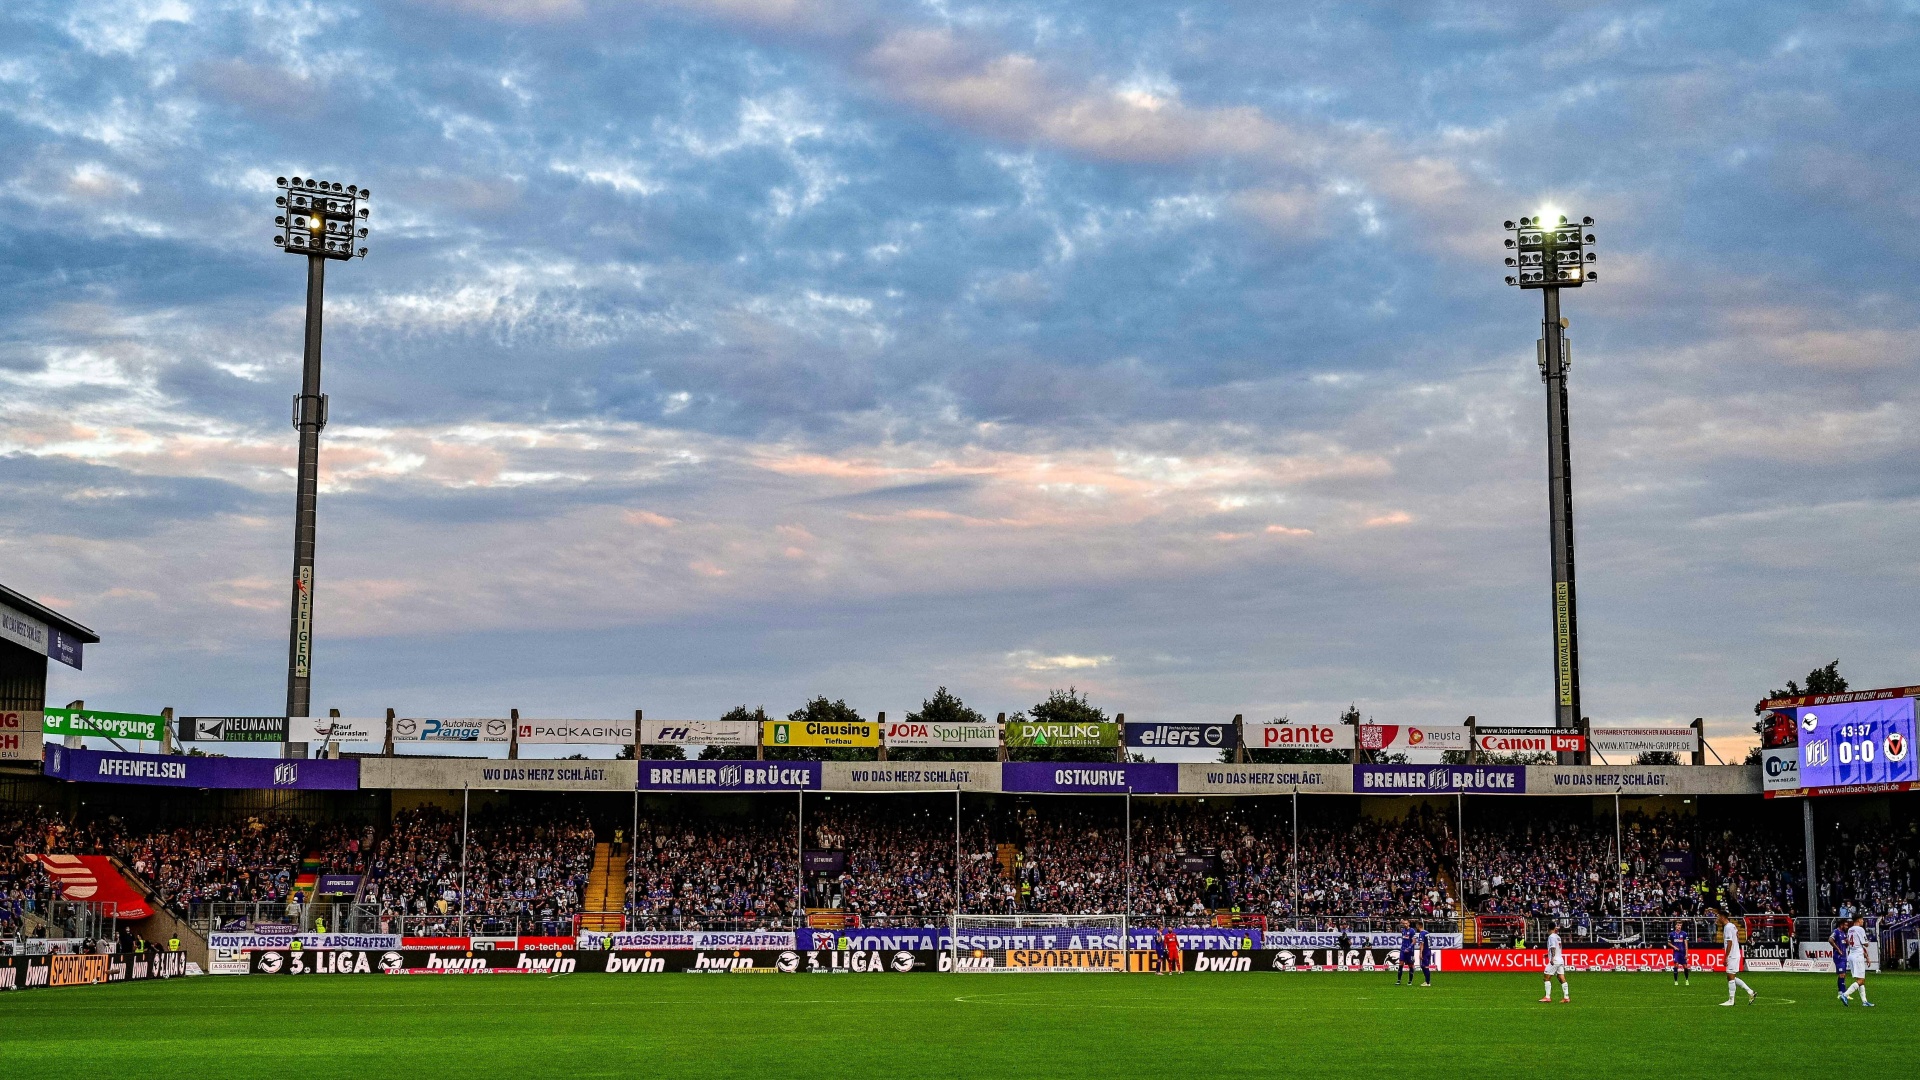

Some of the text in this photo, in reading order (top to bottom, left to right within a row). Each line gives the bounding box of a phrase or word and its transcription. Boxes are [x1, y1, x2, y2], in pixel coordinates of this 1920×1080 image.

[1557, 583, 1568, 636] IBBENBÜREN
[1560, 638, 1570, 695] KLETTERWALD
[1827, 694, 1853, 703] DENKEN
[70, 713, 155, 738] Entsorgung
[225, 719, 282, 731] NEUMANN
[420, 719, 480, 740] Prange
[441, 720, 482, 728] Autohaus
[806, 723, 870, 738] Clausing
[888, 724, 928, 737] JOPA
[1022, 725, 1100, 738] DARLING
[1841, 725, 1871, 737] 43:37
[226, 733, 245, 741] ZELTE
[255, 732, 282, 741] PLANEN
[535, 727, 632, 737] PACKAGING
[658, 728, 689, 740] FH
[1140, 726, 1200, 745] ellers
[1264, 725, 1334, 747] pante
[1428, 731, 1461, 740] neusta
[1482, 736, 1546, 750] Canon
[1556, 736, 1579, 751] brg
[1597, 741, 1690, 750] WWW.KITZMANN-GRUPPE.DE
[99, 758, 186, 779] AFFENFELSEN
[1767, 757, 1797, 772] noz
[274, 763, 297, 785] VFL
[483, 767, 607, 781] WO DAS HERZ SCHLÄGT.
[650, 768, 717, 784] BREMER
[744, 765, 810, 785] BRÜCKE
[852, 768, 972, 783] WO DAS HERZ SCHLÄGT.
[1055, 769, 1125, 786] OSTKURVE
[1207, 770, 1324, 785] WO DAS HERZ SCHLÄGT.
[1363, 772, 1426, 788] BREMER
[1452, 769, 1515, 788] BRÜCKE
[1554, 772, 1668, 786] WO DAS HERZ SCHLÄGT.
[1818, 784, 1899, 795] www.waldbach-logistik.de
[211, 936, 396, 948] MONTAGSSPLE ABSCHAFFEN!
[524, 942, 574, 951] so-tech.eu
[701, 935, 789, 946] ABSCHAFFEN!
[1068, 935, 1241, 950] ABSCHFFEN!
[1265, 935, 1366, 946] MONTAGSSPLE
[1741, 944, 1790, 957] Hrforder
[132, 953, 148, 979] bwin
[289, 951, 371, 975] 3. LIGA
[427, 951, 487, 971] bwin
[517, 951, 577, 973] bwin
[605, 951, 665, 973] bwin
[695, 951, 754, 971] bwin
[832, 951, 884, 972] LIGA
[1195, 950, 1251, 972] bwin
[0, 957, 17, 987] win
[25, 956, 49, 987] bwin
[52, 955, 107, 984] SPORTWETTEN
